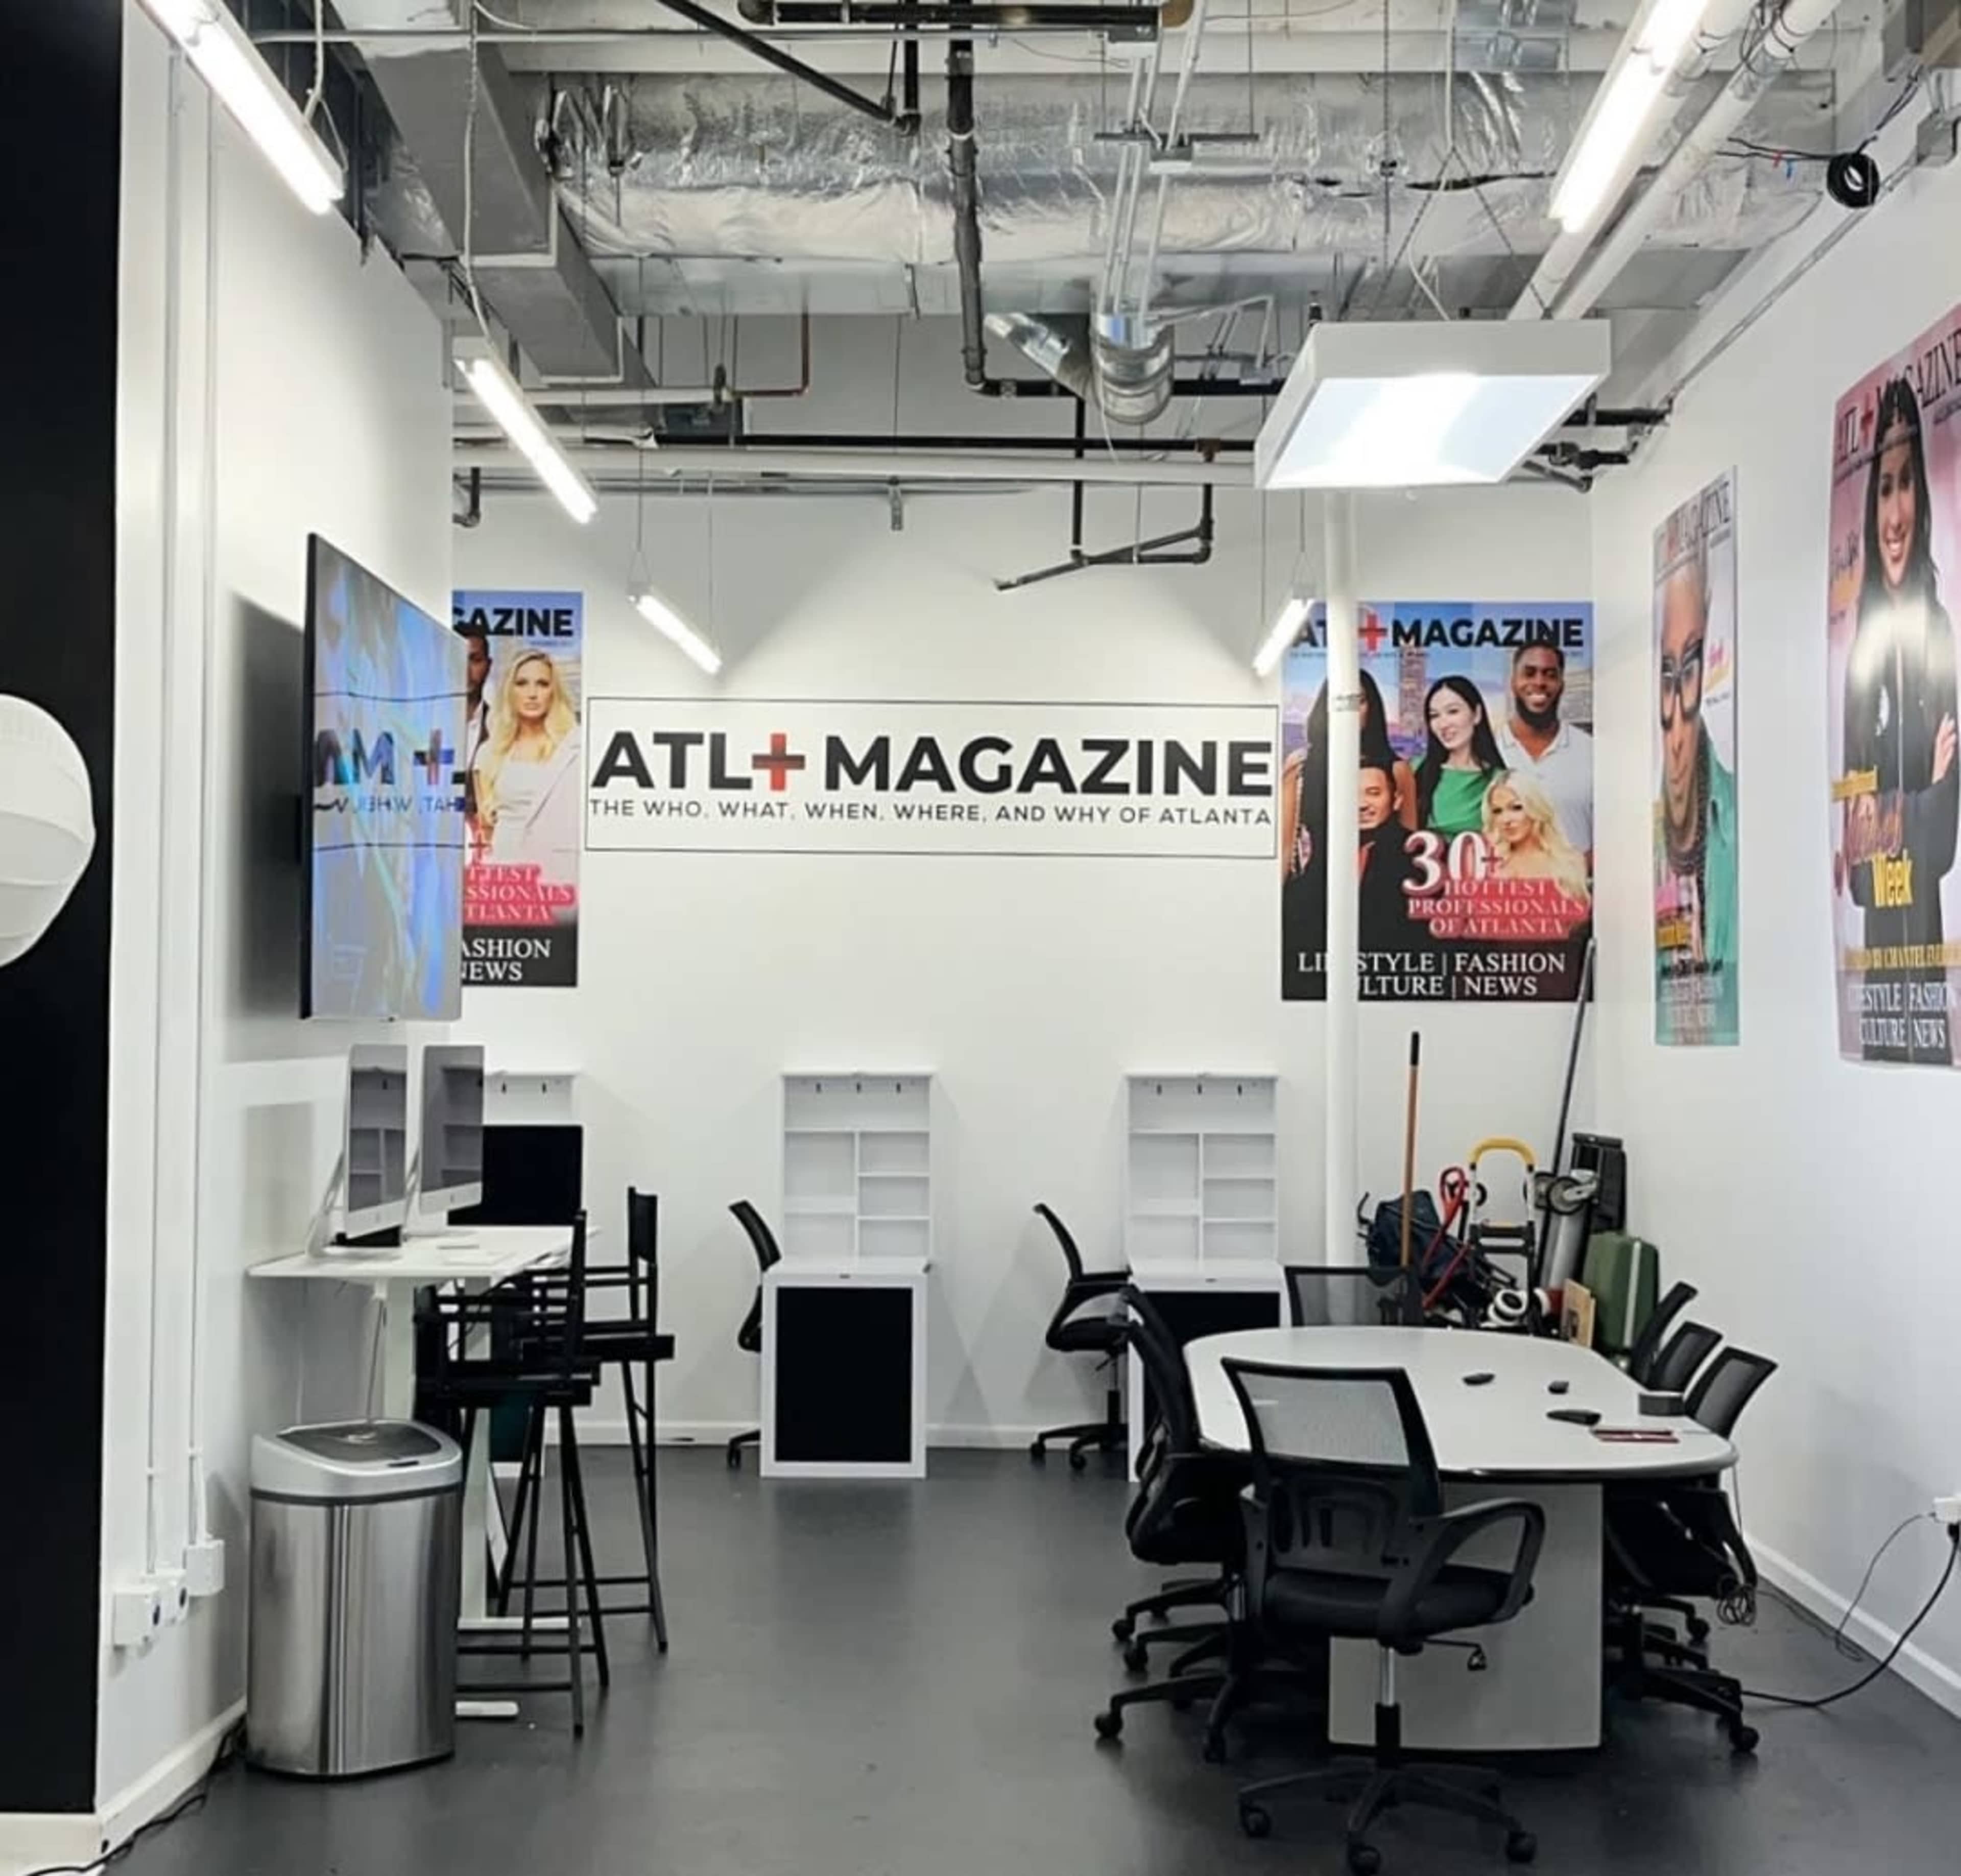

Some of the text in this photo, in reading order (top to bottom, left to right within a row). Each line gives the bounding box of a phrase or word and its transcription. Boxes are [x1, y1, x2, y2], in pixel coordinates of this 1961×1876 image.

[1392, 619, 1583, 648] MAGAZINE
[825, 735, 1273, 796] MAGAZINE
[590, 799, 634, 816] THE
[995, 805, 1045, 822] AND
[1055, 806, 1111, 823] WHY
[1119, 807, 1151, 823] OF
[1159, 808, 1272, 824] ATLANTA
[1444, 880, 1546, 896] HOTTEST
[1871, 849, 1912, 907] Week
[1407, 898, 1585, 915] PROFESSIONALS
[1430, 918, 1564, 934] OF ATLANTA
[1454, 952, 1566, 973] FASHION
[1464, 976, 1538, 996] NEWS
[1914, 1018, 1946, 1048] NEWS
